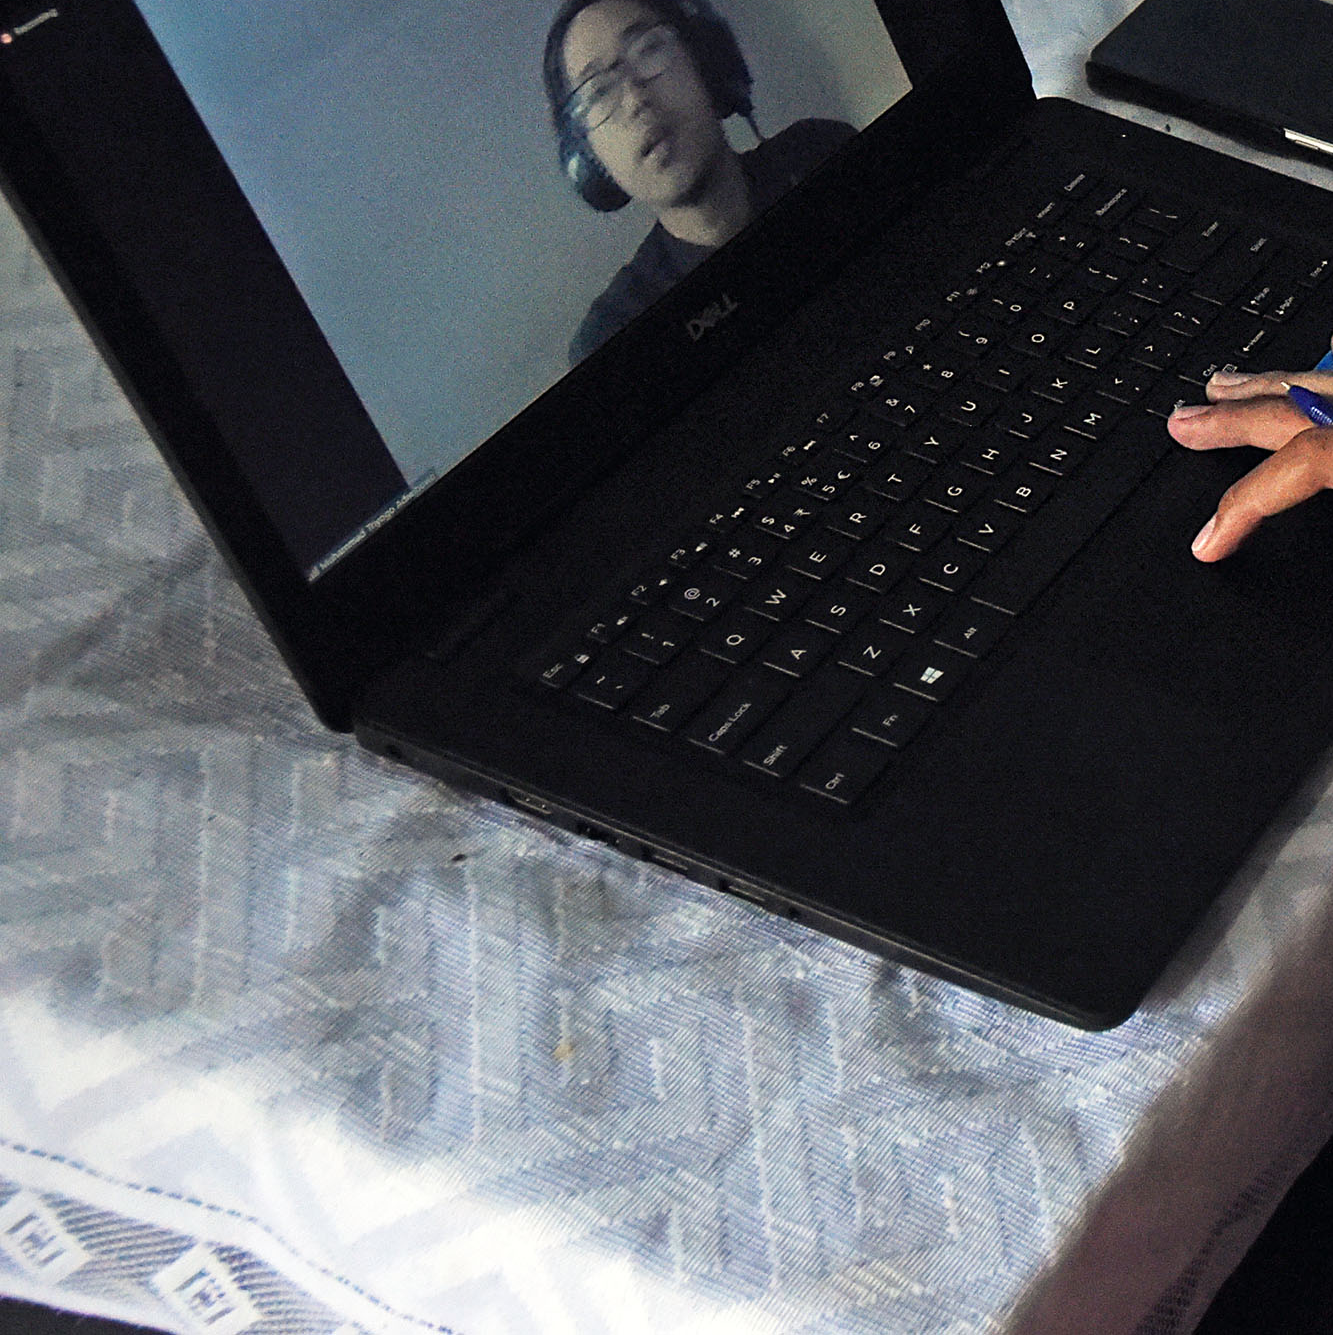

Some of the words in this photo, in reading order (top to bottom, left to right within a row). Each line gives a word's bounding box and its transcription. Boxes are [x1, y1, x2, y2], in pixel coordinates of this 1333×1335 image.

[1064, 302, 1074, 310] P
[686, 293, 740, 341] DELL
[1032, 334, 1044, 342] O
[1052, 378, 1068, 388] K
[905, 405, 915, 413] 7
[961, 401, 976, 411] U
[817, 413, 828, 423] F7
[1022, 413, 1032, 422] J
[1084, 413, 1101, 425] M
[924, 437, 939, 445] Y
[782, 446, 795, 456] F6
[982, 449, 999, 459] H
[1050, 449, 1067, 460] N
[801, 477, 817, 485] %
[888, 474, 902, 482] T
[746, 480, 760, 489] F5
[822, 485, 835, 493] 5
[948, 486, 962, 496] G
[1016, 487, 1031, 497] B
[710, 514, 723, 524] F4
[762, 517, 774, 525] $
[849, 513, 866, 523] R
[909, 524, 920, 534] F
[979, 524, 993, 533] V
[671, 549, 685, 560] F3
[809, 552, 826, 562] E
[748, 557, 761, 565] 3
[869, 564, 885, 575] D
[944, 564, 958, 574] C
[631, 585, 647, 596] F2
[684, 588, 700, 600] @
[765, 589, 786, 604] W
[706, 598, 720, 607] 2
[831, 605, 846, 616] S
[903, 604, 921, 616] X
[591, 623, 605, 633] F1
[726, 635, 745, 645] Q
[791, 650, 806, 659] A
[863, 646, 881, 658] Z
[648, 704, 671, 720] Tab
[709, 718, 733, 742] Caps
[728, 703, 751, 722] Lock
[883, 715, 898, 726] Fn
[763, 745, 787, 767] Shift
